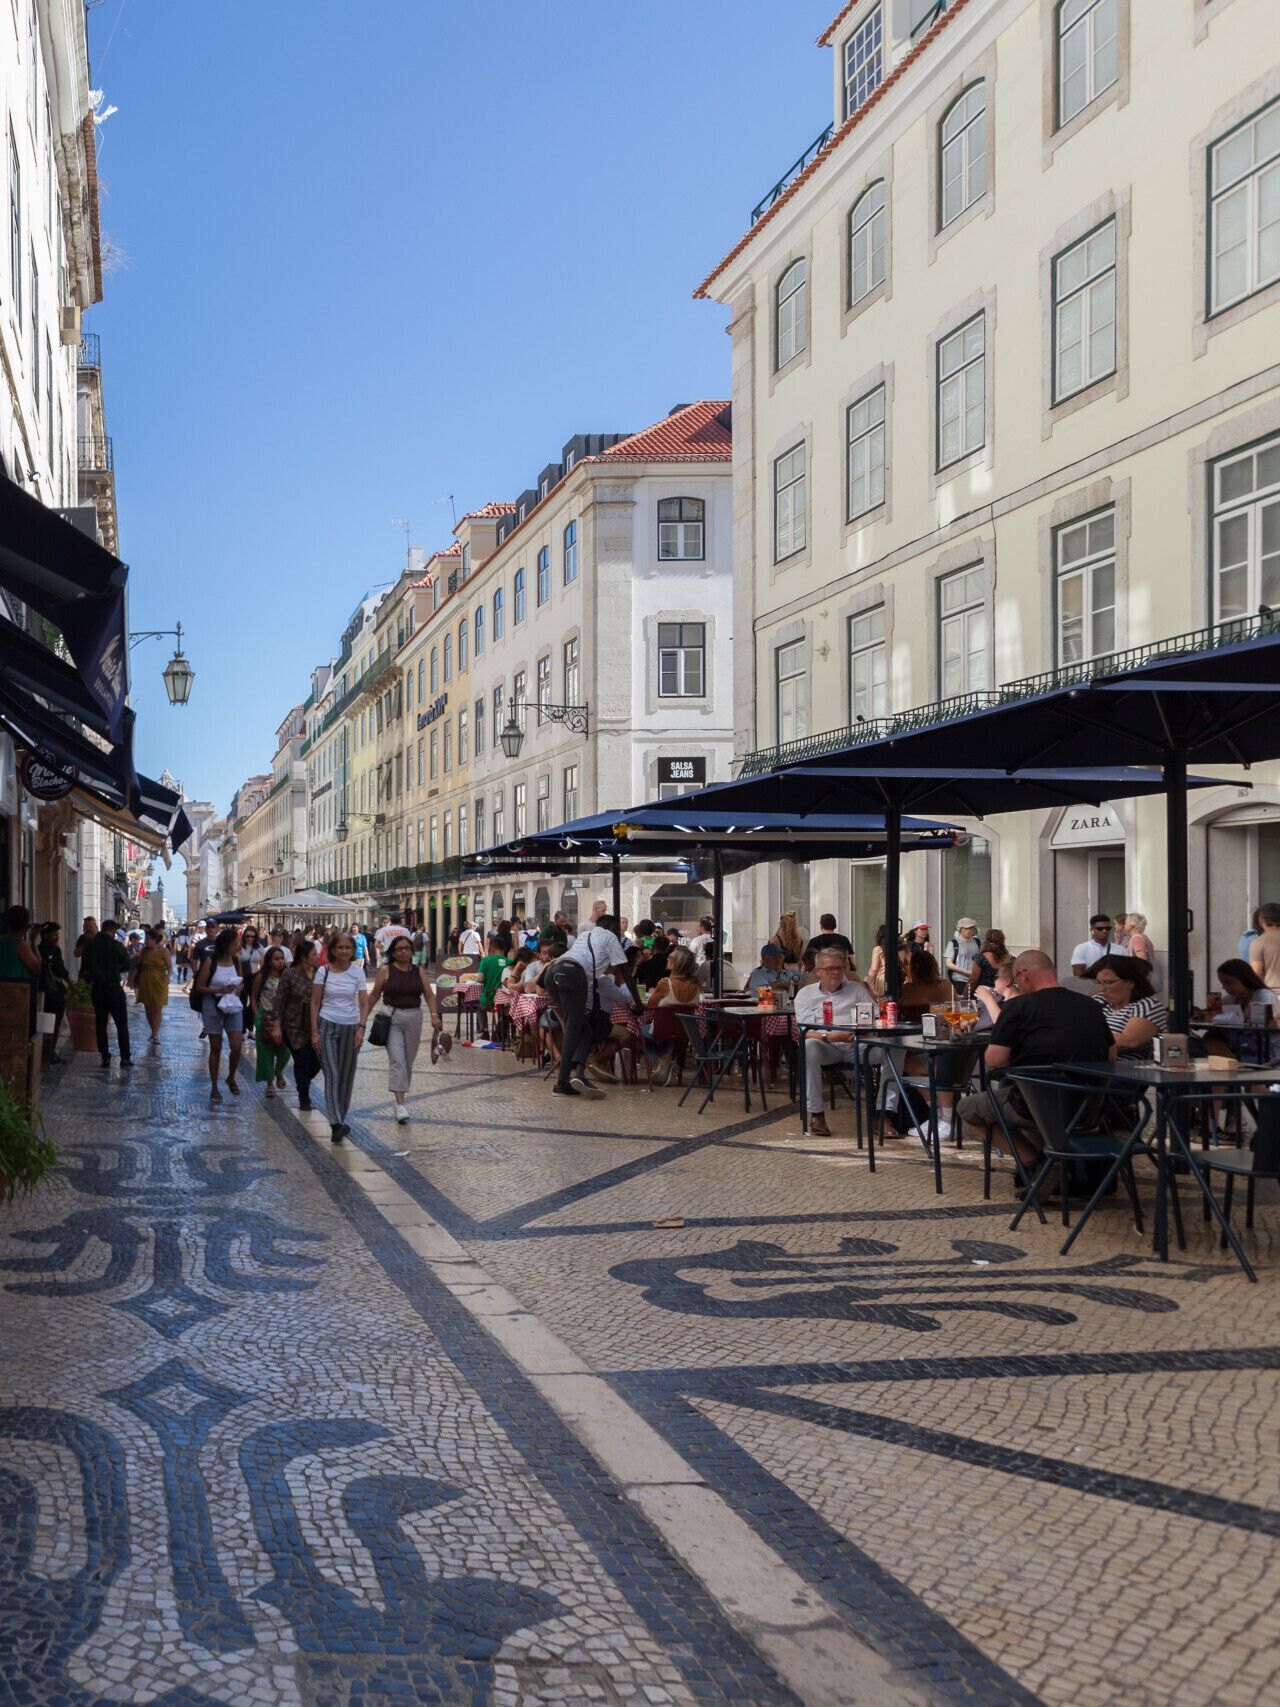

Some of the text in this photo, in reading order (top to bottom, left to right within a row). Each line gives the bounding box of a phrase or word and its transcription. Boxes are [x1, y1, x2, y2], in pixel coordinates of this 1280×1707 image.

[670, 761, 694, 770] SALSA
[670, 769, 694, 779] JEANS
[1071, 817, 1111, 830] ZARA
